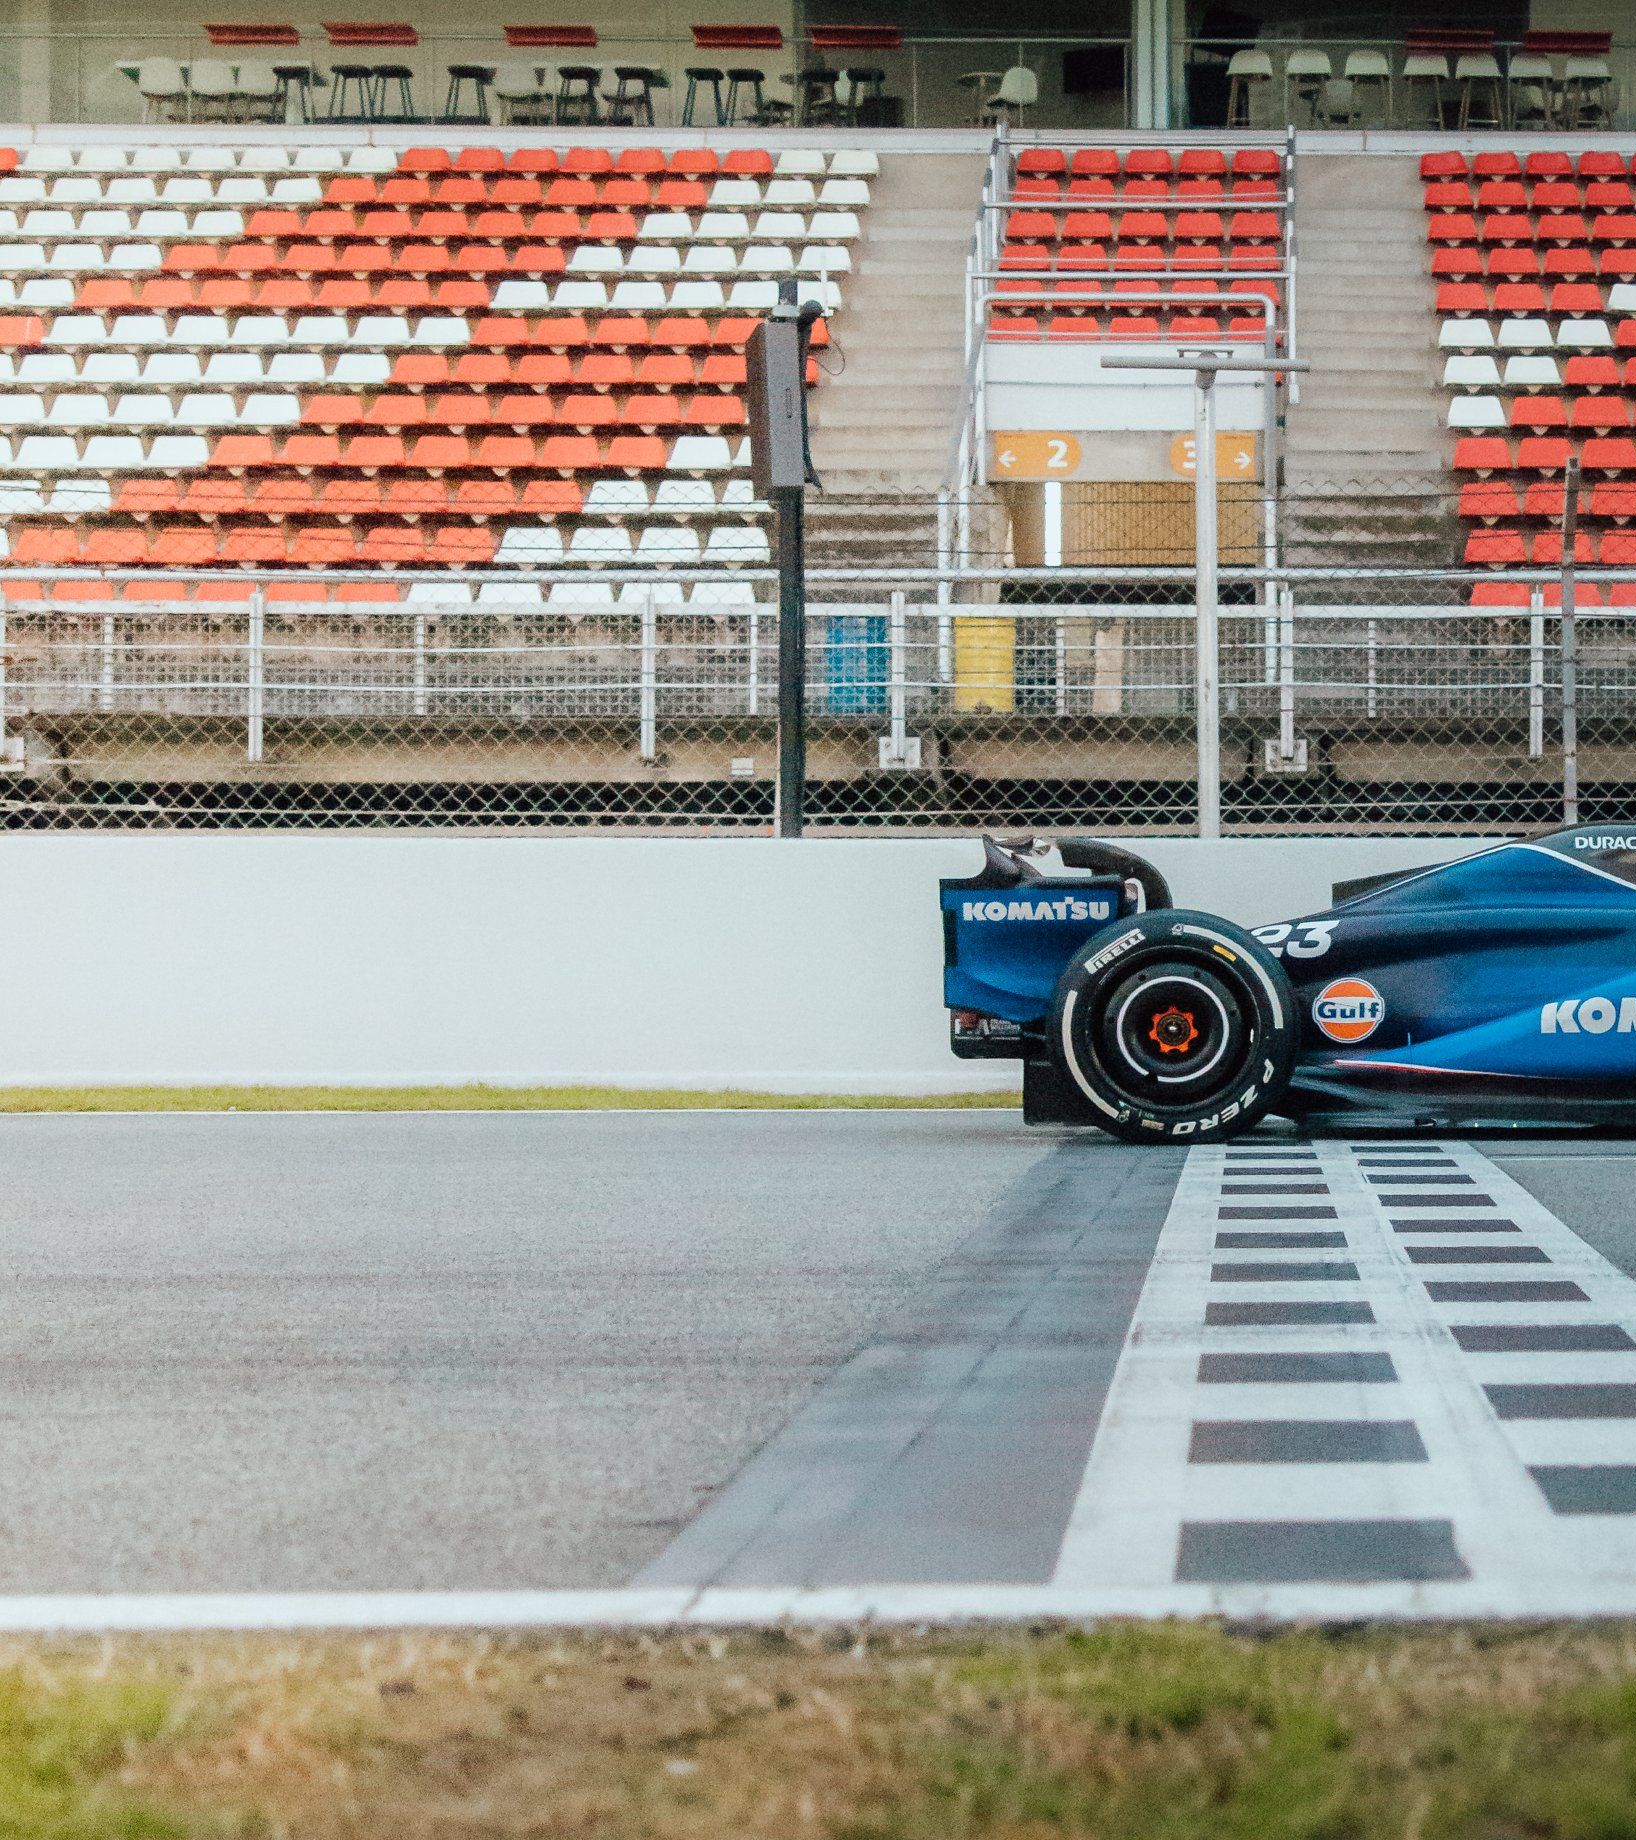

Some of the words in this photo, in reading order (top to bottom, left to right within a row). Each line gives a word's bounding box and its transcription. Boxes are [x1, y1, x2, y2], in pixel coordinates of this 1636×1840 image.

[1047, 439, 1068, 468] 2
[962, 896, 1110, 921] KOMATSU
[1083, 928, 1147, 975] PIRELLI
[1251, 920, 1341, 959] 23
[1317, 1002, 1380, 1019] Gulf
[1171, 1084, 1259, 1135] ZERO
